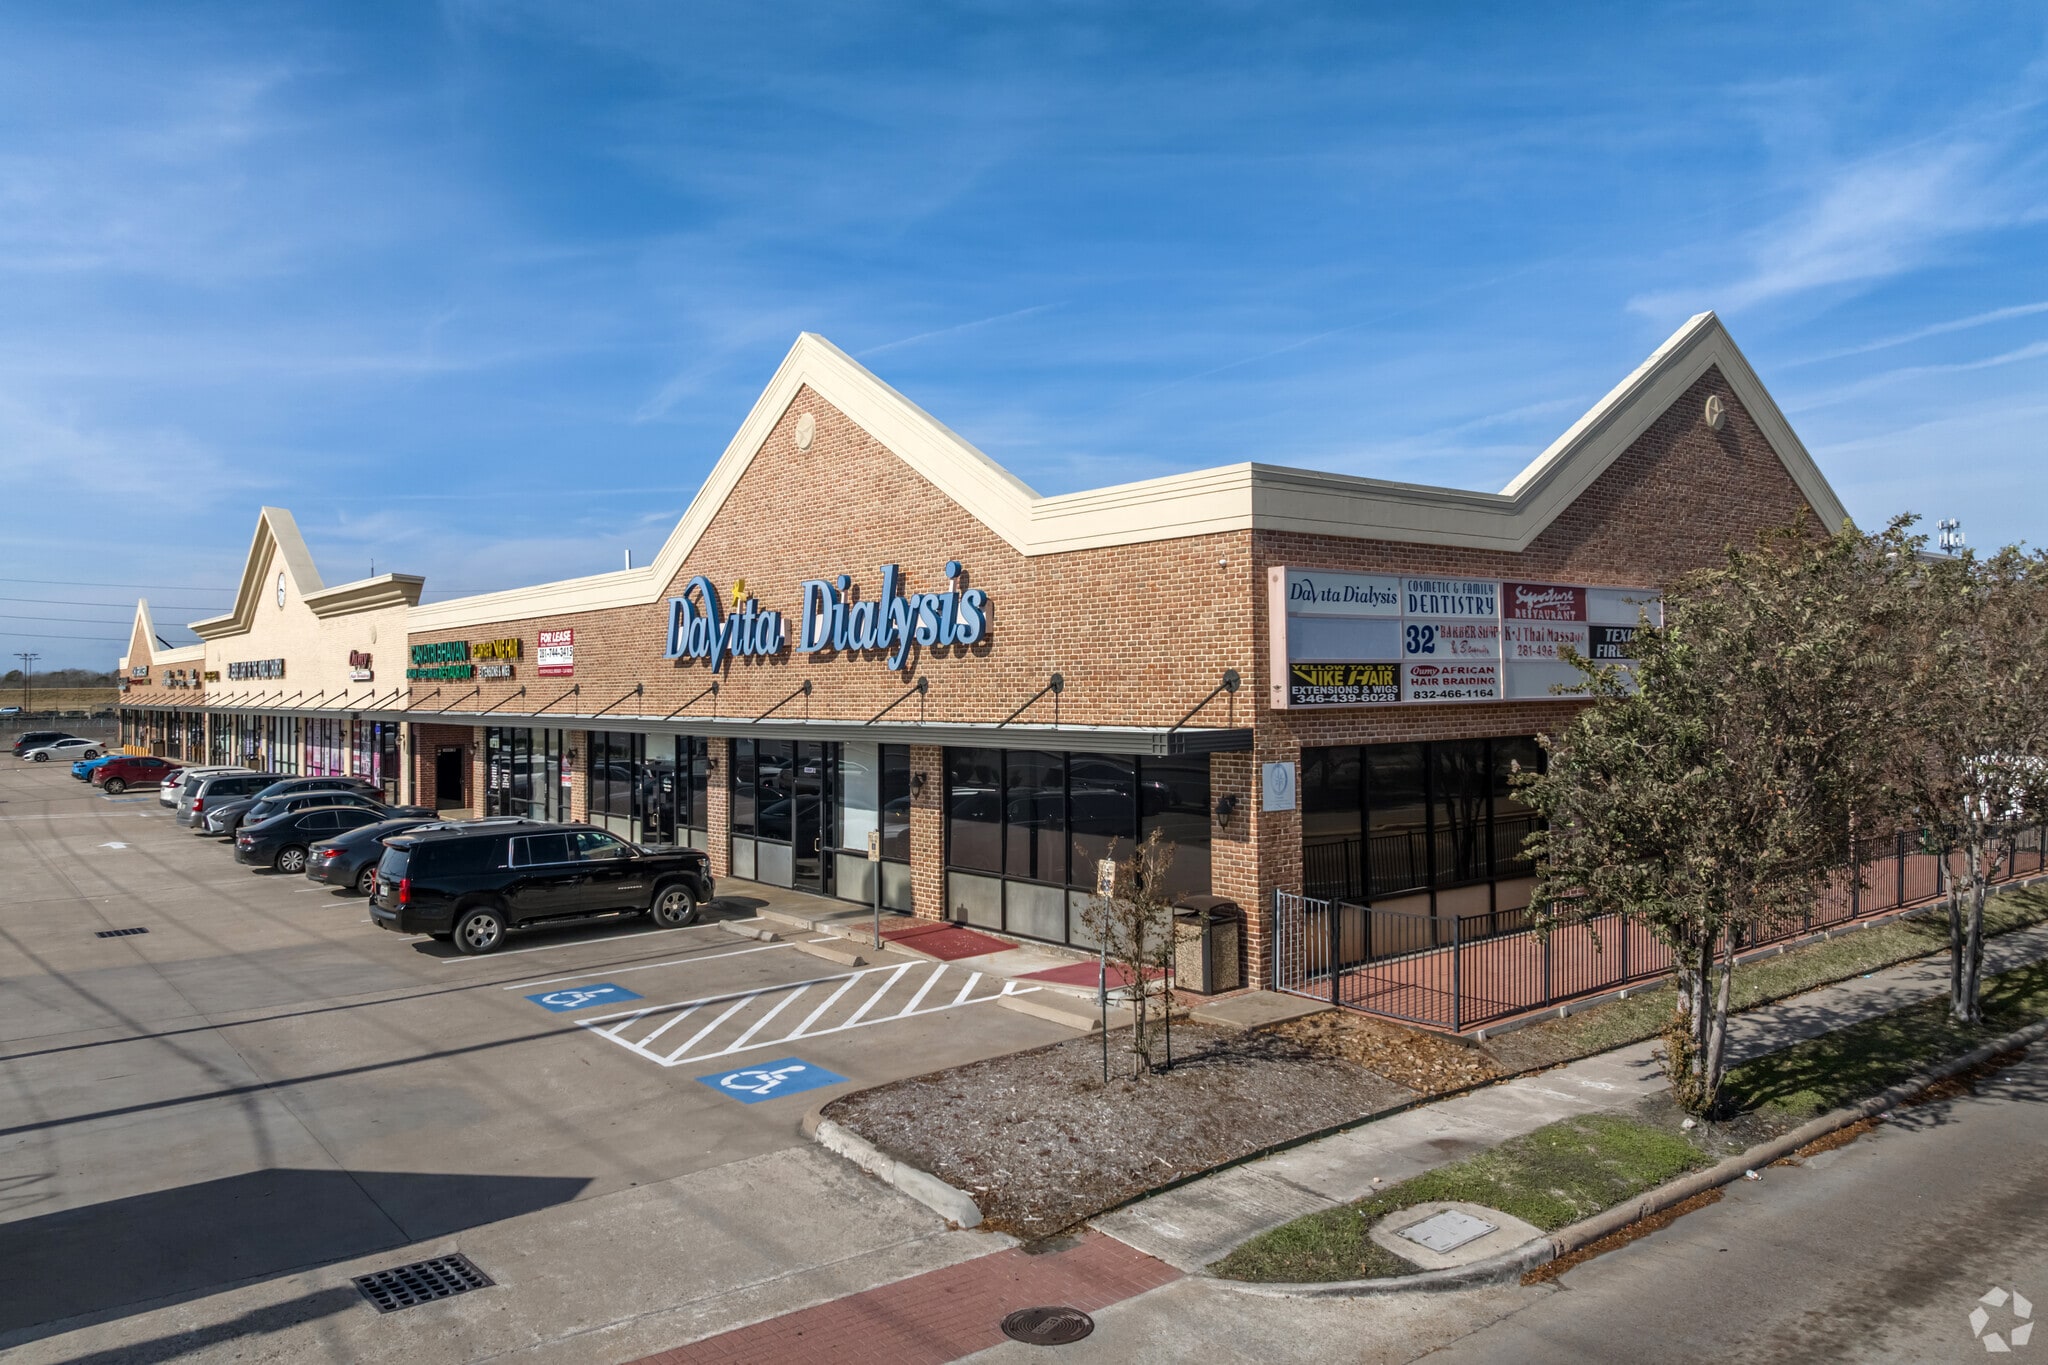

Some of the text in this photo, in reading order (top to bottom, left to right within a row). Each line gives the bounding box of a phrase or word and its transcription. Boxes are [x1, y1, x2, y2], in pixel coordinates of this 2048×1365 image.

[1290, 579, 1397, 607] DaVita Dialysis
[1408, 580, 1494, 595] COSMETIC & FAMILY
[1516, 586, 1574, 606] Signature
[1409, 594, 1494, 615] DENTISTRY
[662, 561, 987, 674] DaVita Dialysis
[1515, 608, 1576, 621] RESTAURANT
[540, 631, 571, 643] FOR LEASE
[1440, 626, 1476, 638] BARBER
[1523, 625, 1545, 641] Thai
[437, 641, 466, 662] BHAVAN
[1293, 671, 1393, 686] VIKE HAIR
[1411, 678, 1495, 686] HAIR BRAIDING
[1292, 686, 1359, 694] EXTENSIONS
[1373, 685, 1398, 693] WIGS
[1414, 689, 1494, 699] 832-466-1164
[1297, 694, 1396, 703] 346-439-6028
